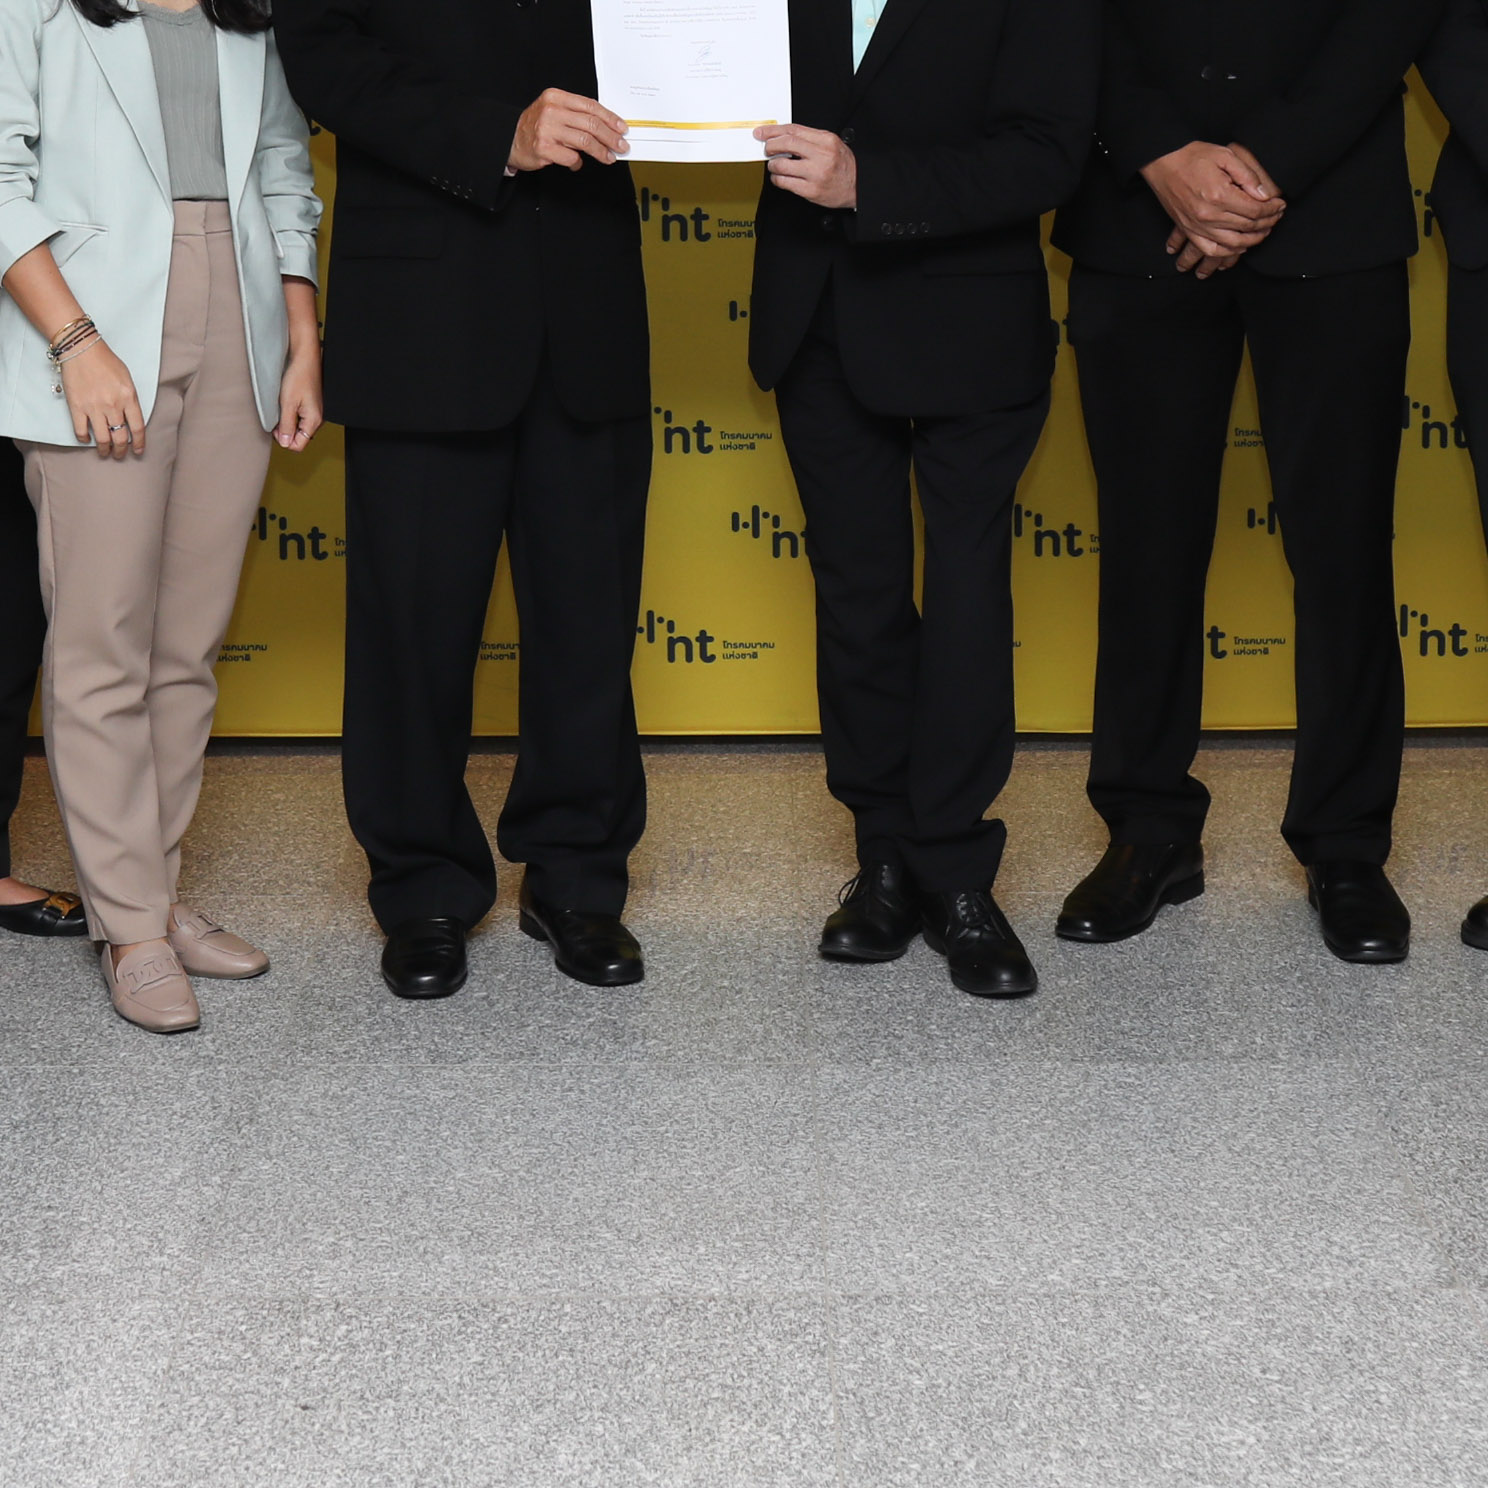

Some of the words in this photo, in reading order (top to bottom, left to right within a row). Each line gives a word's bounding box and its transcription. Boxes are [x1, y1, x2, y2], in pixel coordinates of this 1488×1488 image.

[661, 206, 712, 243] nt
[664, 419, 714, 455] nt
[279, 526, 329, 561] nt
[772, 530, 808, 559] n
[1034, 522, 1084, 557] nt
[667, 629, 717, 664] nt
[1419, 623, 1469, 657] nt
